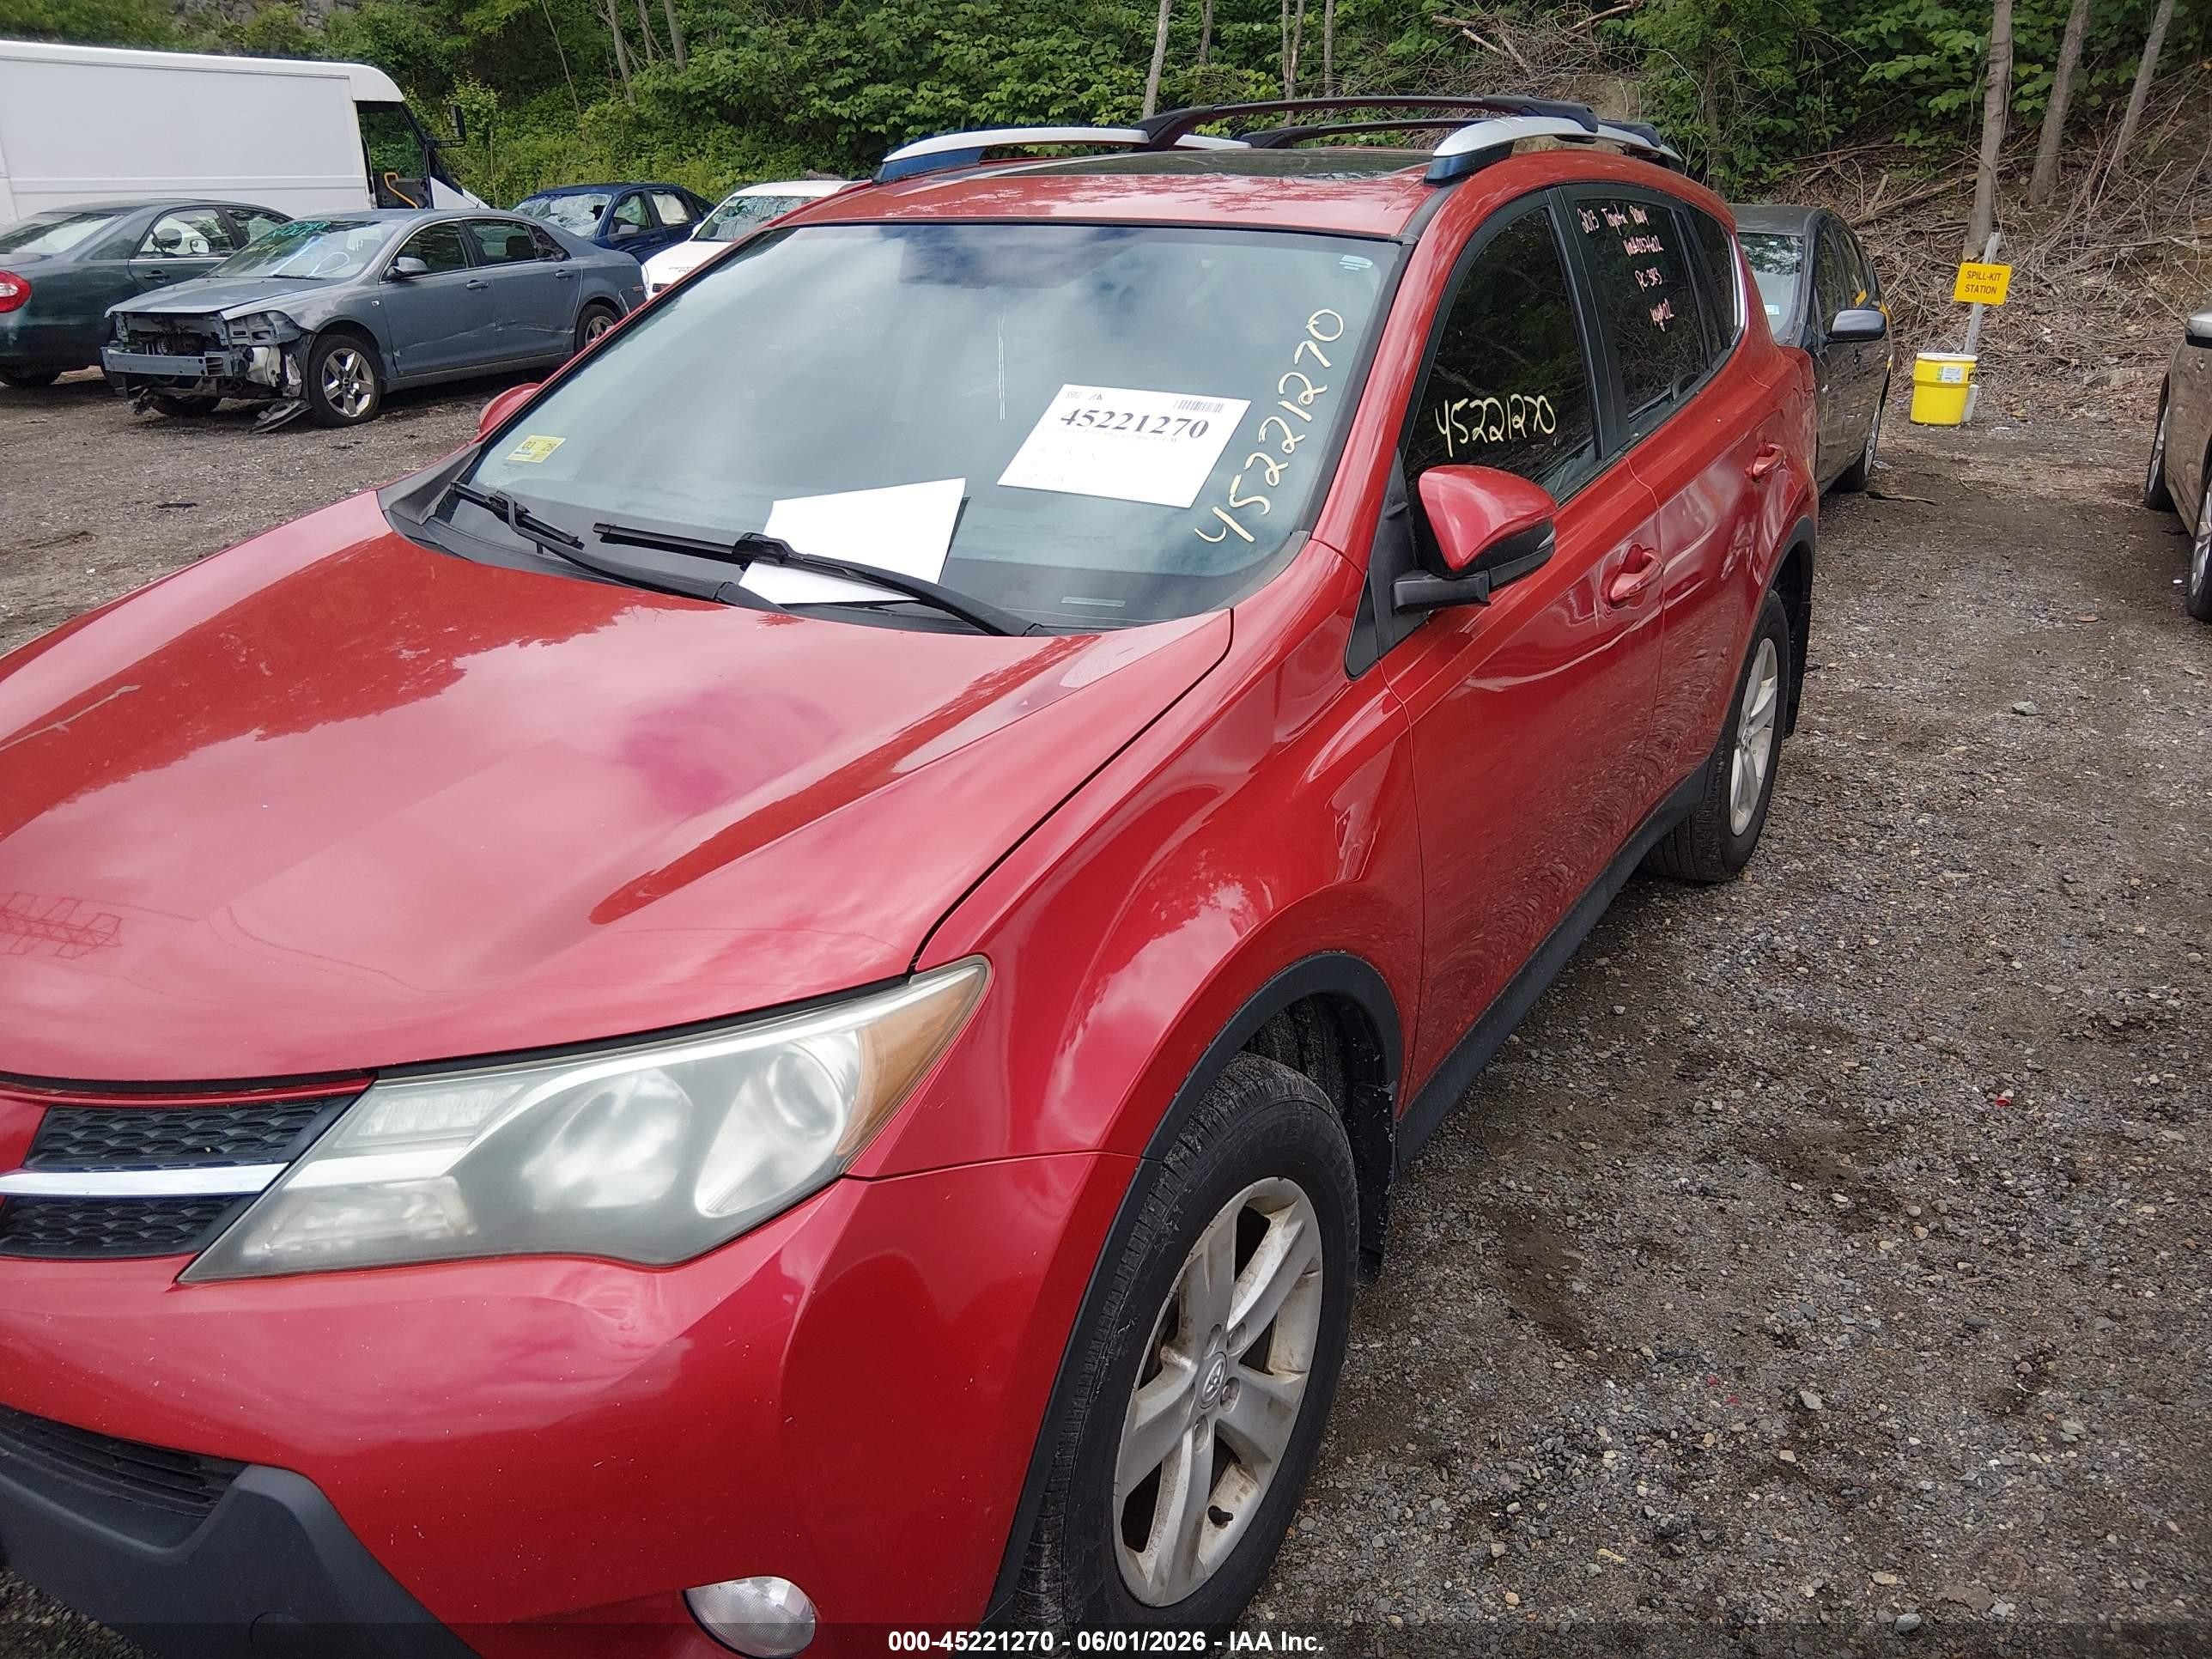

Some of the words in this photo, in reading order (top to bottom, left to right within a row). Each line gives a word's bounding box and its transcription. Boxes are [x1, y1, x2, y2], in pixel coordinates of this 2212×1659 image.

[1964, 283, 1997, 295] STATION
[1966, 270, 2002, 283] SPILL-KIT
[1060, 407, 1209, 440] 45221270
[1194, 308, 1345, 544] 45221270
[1434, 393, 1556, 458] 45221270
